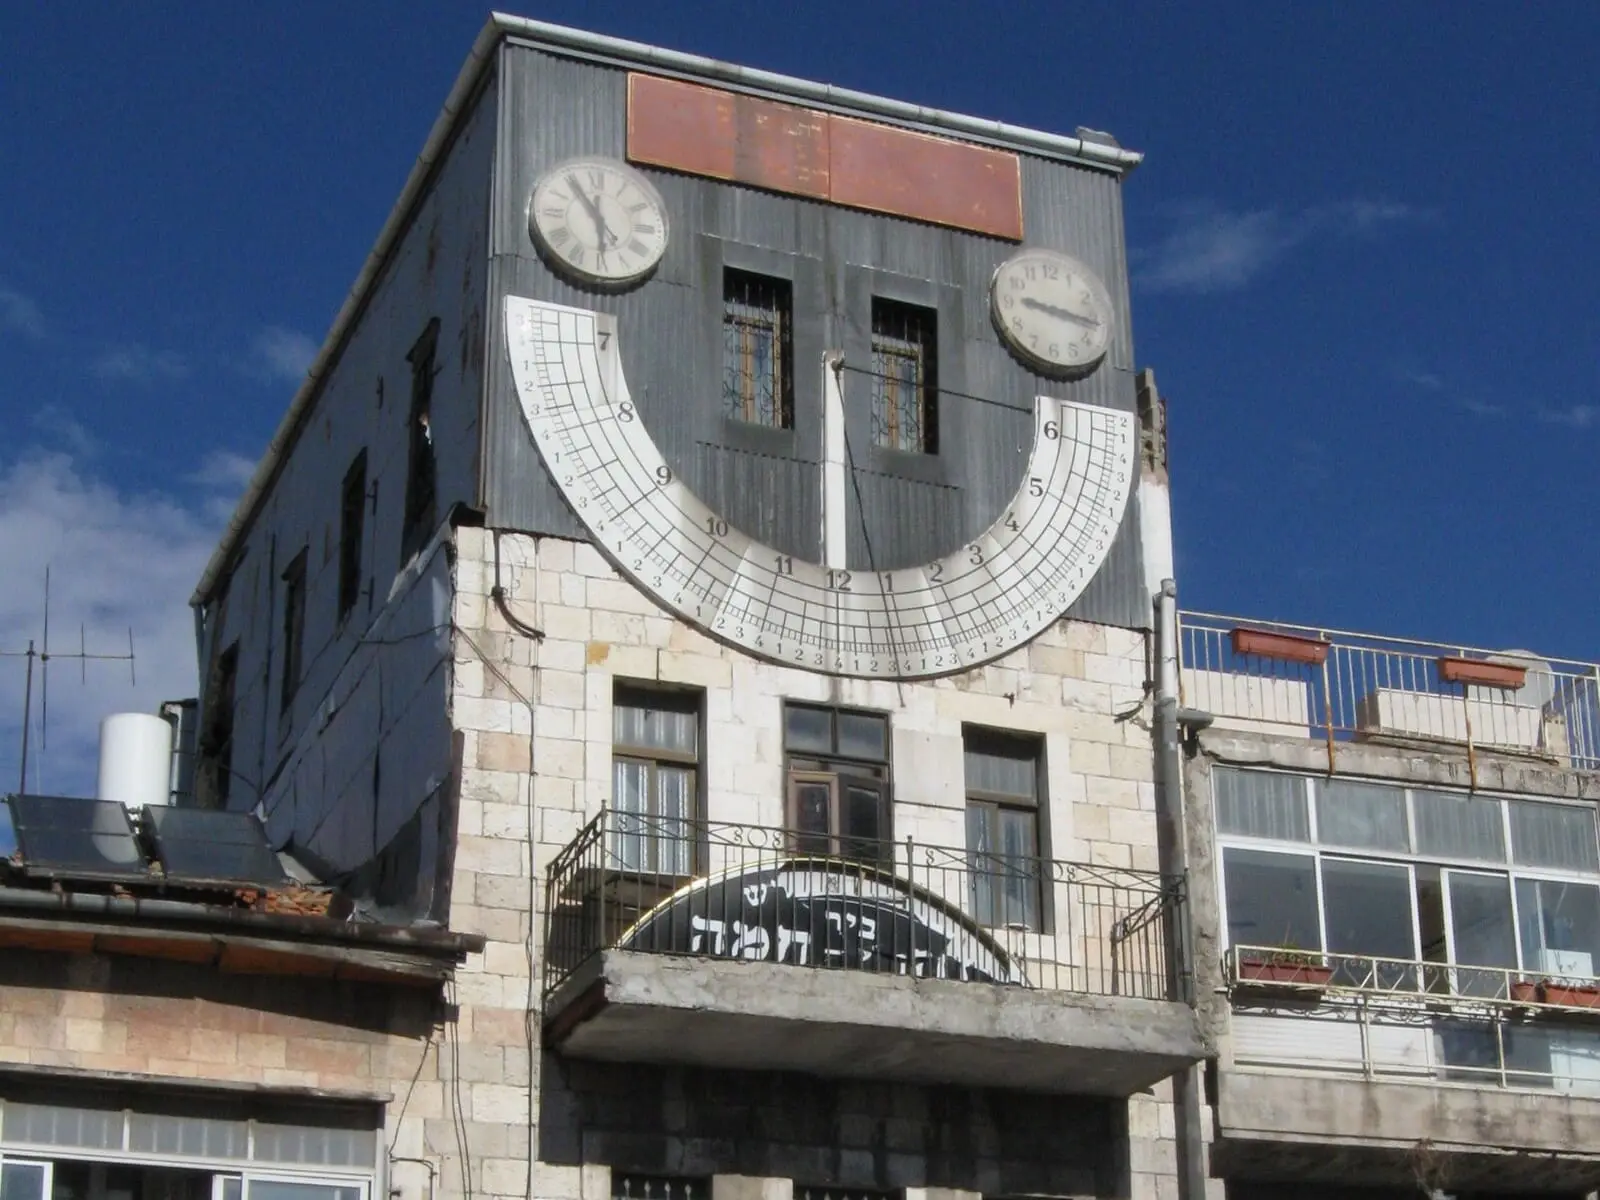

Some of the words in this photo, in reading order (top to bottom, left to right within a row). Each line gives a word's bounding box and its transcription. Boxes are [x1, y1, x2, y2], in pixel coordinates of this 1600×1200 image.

[1024, 267, 1037, 280] 11
[1042, 265, 1058, 280] 12
[597, 332, 612, 351] 7
[1029, 334, 1038, 348] 7
[1049, 343, 1059, 358] 6
[1068, 342, 1078, 357] 5
[524, 360, 528, 370] 1
[525, 383, 533, 392] 2
[531, 404, 540, 415] 3
[617, 401, 634, 422] 8
[1044, 421, 1058, 440] 6
[1121, 434, 1126, 444] 1
[555, 452, 559, 463] 1
[565, 475, 573, 487] 2
[656, 465, 672, 486] 9
[1029, 477, 1043, 497] 5
[1113, 490, 1121, 501] 2
[579, 497, 587, 508] 3
[1109, 507, 1114, 518] 1
[706, 517, 728, 537] 10
[1004, 512, 1020, 532] 4
[618, 541, 622, 552] 1
[969, 545, 984, 565] 3
[1088, 554, 1096, 565] 2
[634, 559, 642, 571] 2
[775, 556, 793, 575] 11
[929, 562, 943, 582] 2
[1079, 568, 1084, 578] 1
[653, 576, 662, 588] 3
[826, 569, 852, 592] 12
[885, 573, 893, 592] 1
[1058, 592, 1066, 603] 3
[696, 606, 701, 617] 1
[1045, 603, 1053, 614] 2
[1037, 611, 1041, 621] 1
[717, 618, 725, 629] 2
[735, 626, 744, 639] 3
[1009, 629, 1016, 640] 3
[755, 635, 764, 647] 4
[983, 642, 987, 652] 1
[996, 636, 1003, 648] 2
[777, 643, 781, 654] 1
[967, 648, 975, 659] 4
[795, 649, 804, 661] 2
[814, 653, 823, 665] 3
[949, 653, 957, 665] 3
[854, 660, 859, 670] 1
[870, 661, 878, 672] 2
[888, 661, 897, 672] 3
[904, 661, 911, 671] 4
[921, 659, 926, 670] 1
[935, 656, 943, 667] 2
[691, 914, 811, 965] חמה
